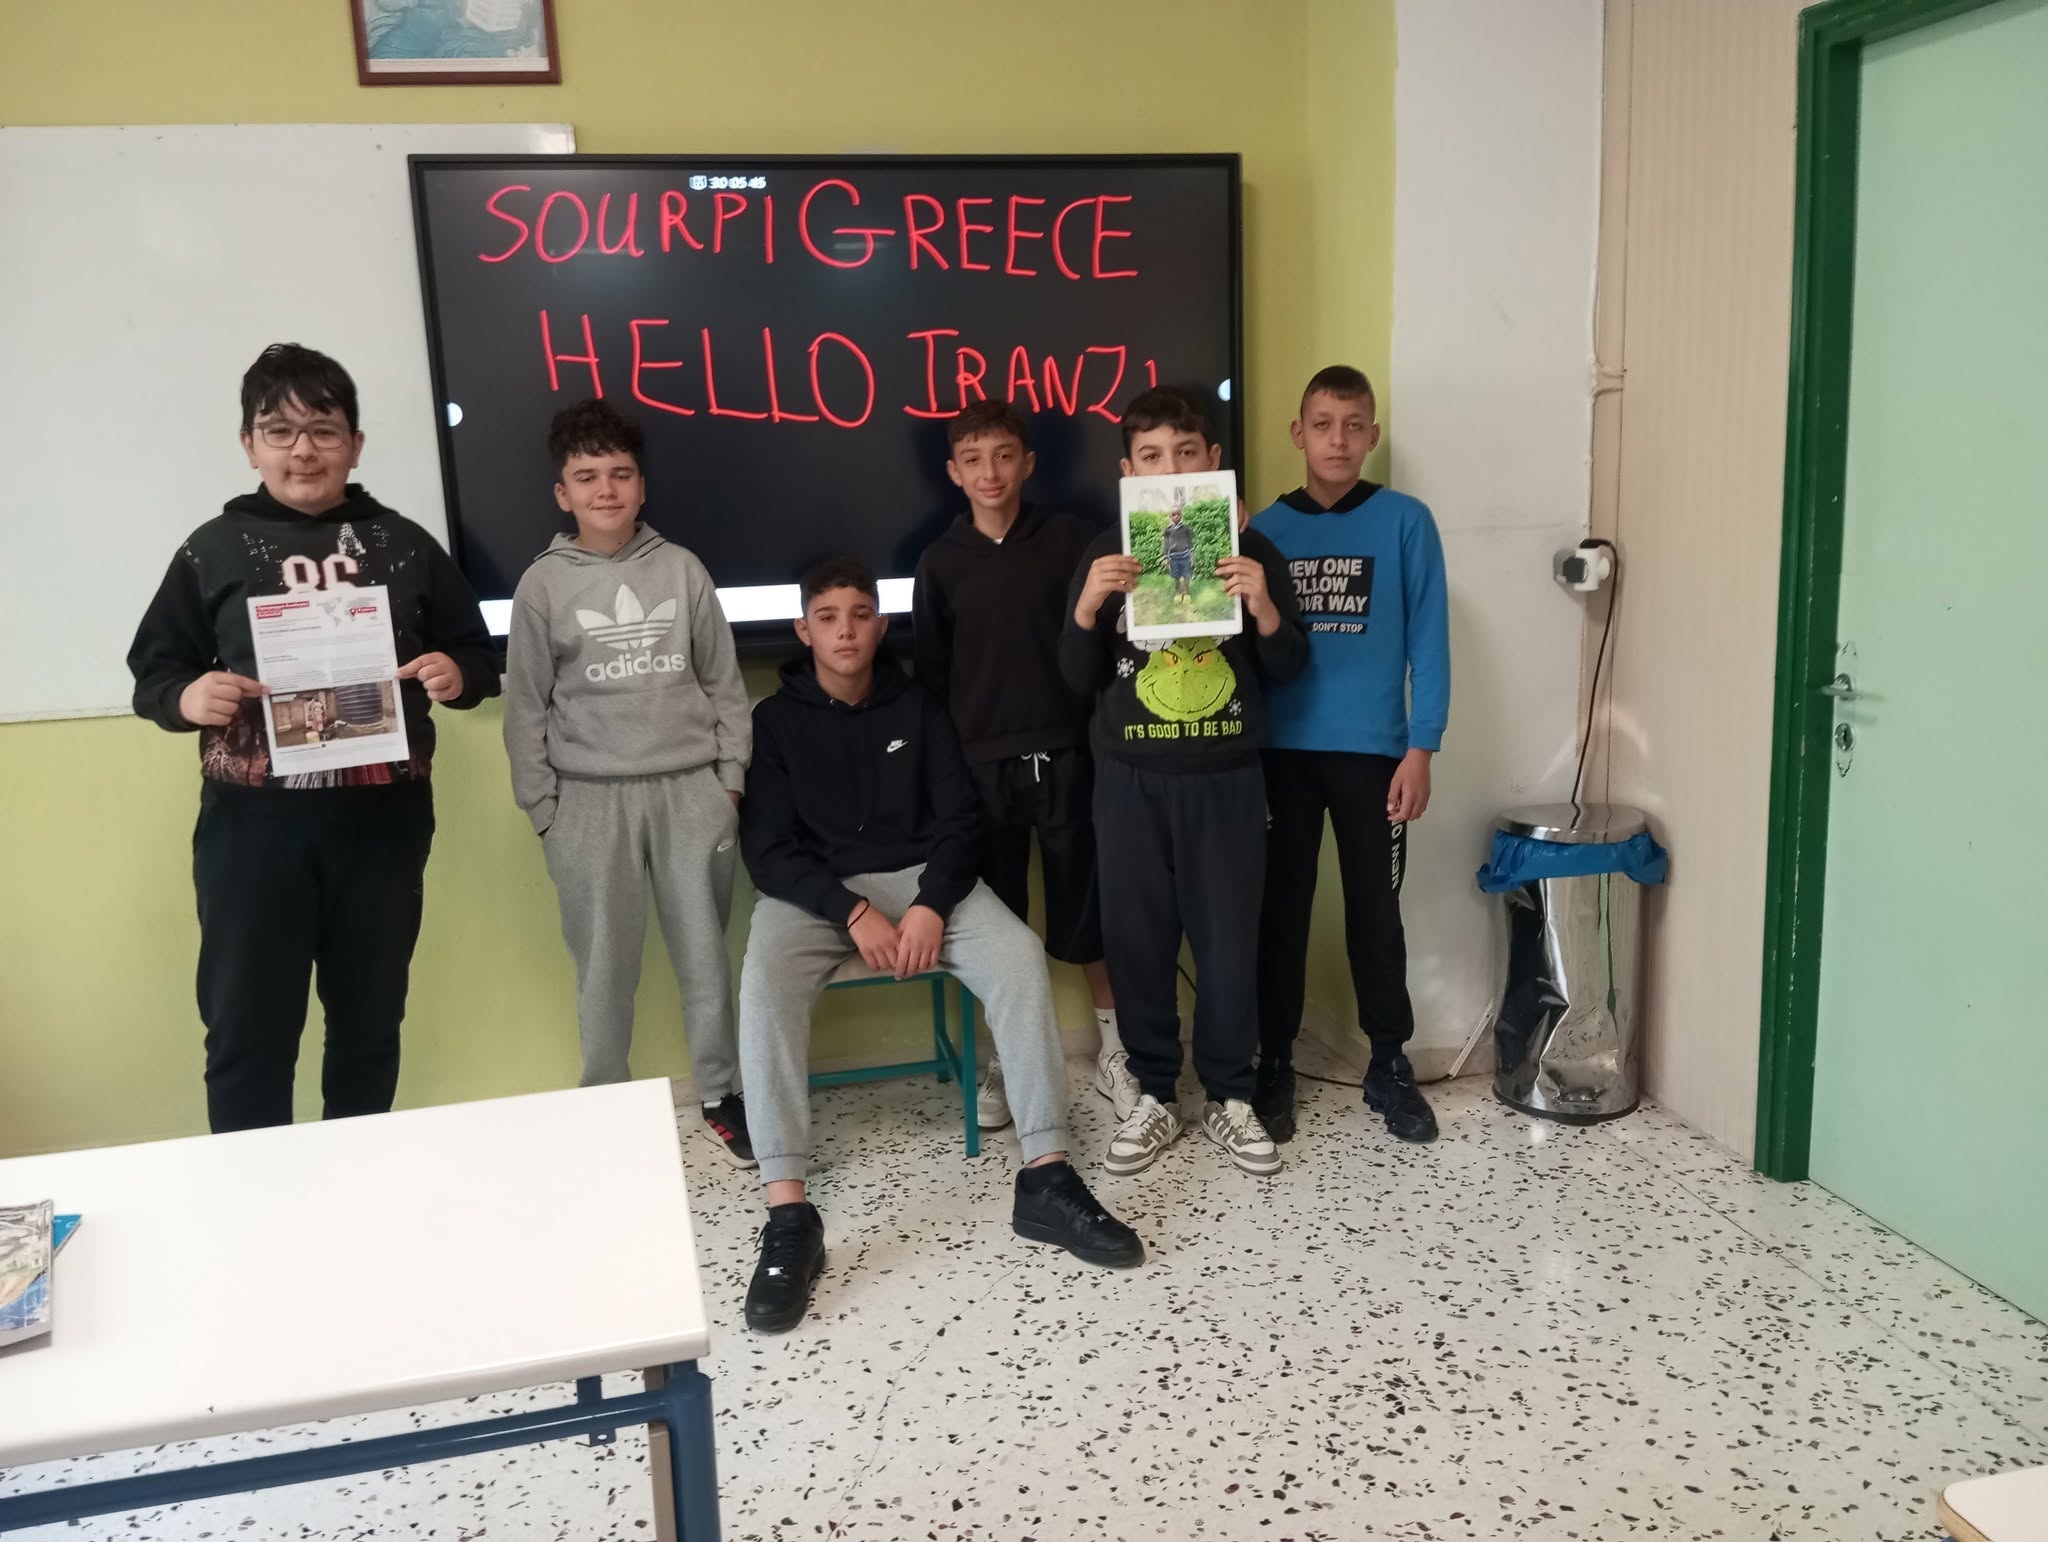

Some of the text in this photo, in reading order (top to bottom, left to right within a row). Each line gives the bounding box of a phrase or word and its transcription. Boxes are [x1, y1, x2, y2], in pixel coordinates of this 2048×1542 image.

[478, 178, 1138, 281] SOURPI GREECE
[539, 309, 876, 430] HELLO
[1322, 558, 1363, 577] ONE
[1292, 576, 1349, 595] OLLOW
[1328, 595, 1368, 613] WAY
[1312, 622, 1364, 634] DON'T STOP
[585, 650, 687, 682] adidas
[1124, 720, 1243, 740] IT'S GOOD TO BE BAD
